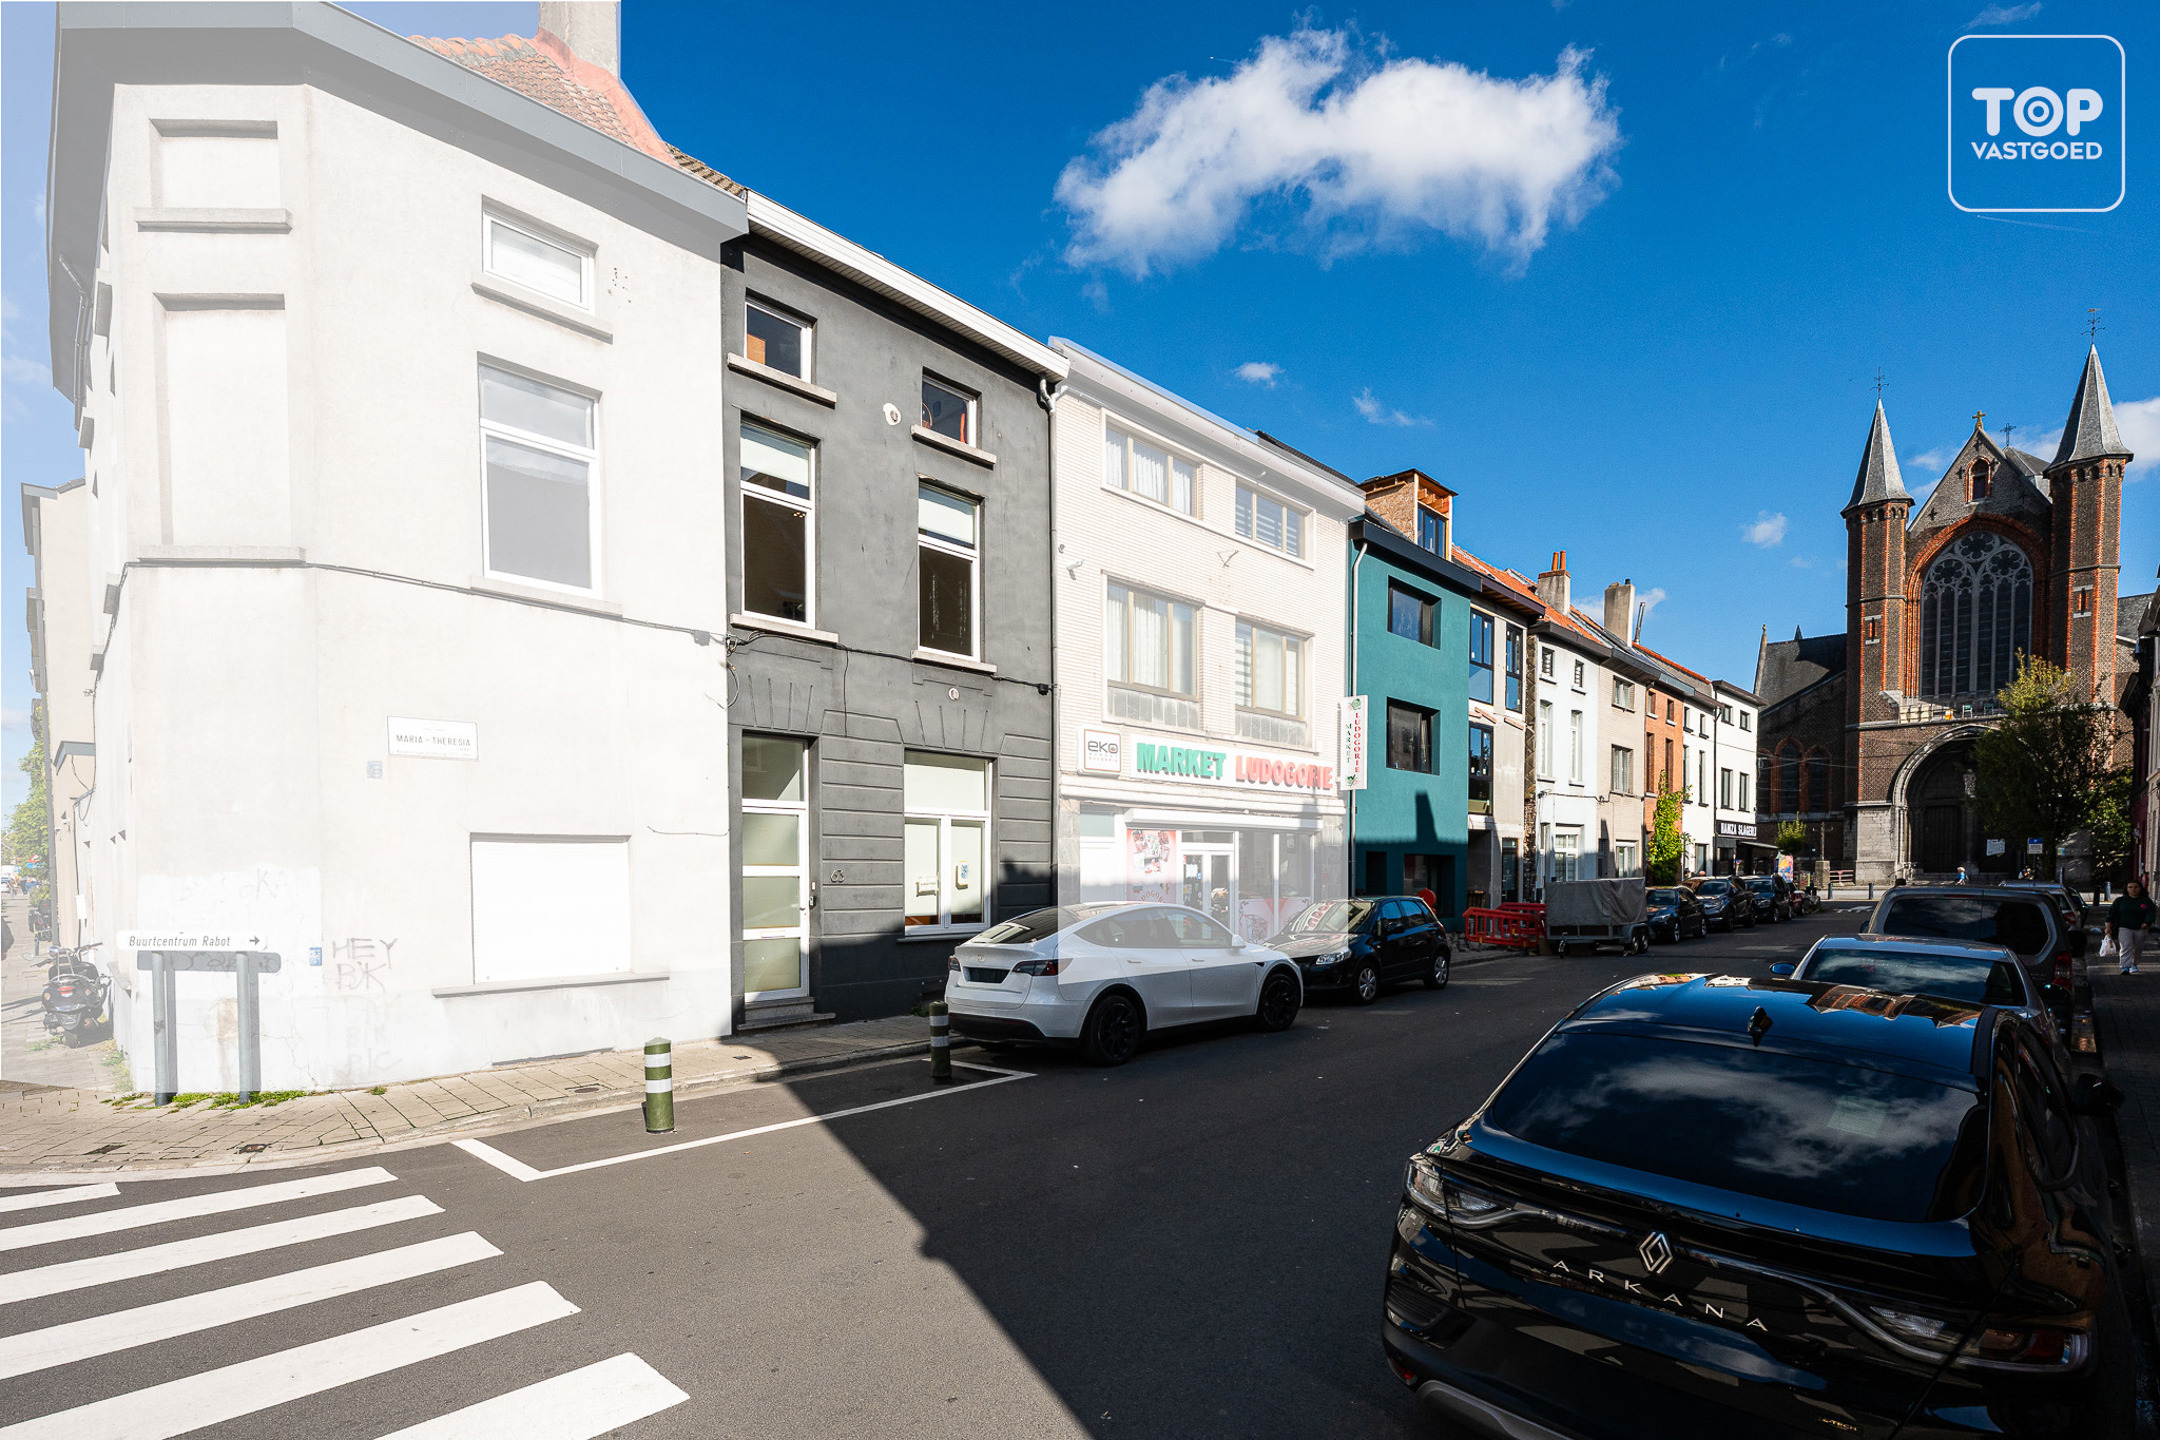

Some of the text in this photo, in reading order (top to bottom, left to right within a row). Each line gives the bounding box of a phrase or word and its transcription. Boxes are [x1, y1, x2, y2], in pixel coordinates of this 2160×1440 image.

[396, 734, 423, 743] MARIA
[432, 736, 471, 746] THERESIA
[1087, 740, 1118, 754] eko
[1353, 712, 1361, 773] LUDOGORIE
[1136, 742, 1333, 790] MARKET LUDOGORIE
[830, 868, 845, 883] 63
[129, 935, 230, 947] Buurtcentrum Rabot
[332, 937, 398, 970] HEY
[1553, 1260, 1768, 1332] ARKANA
